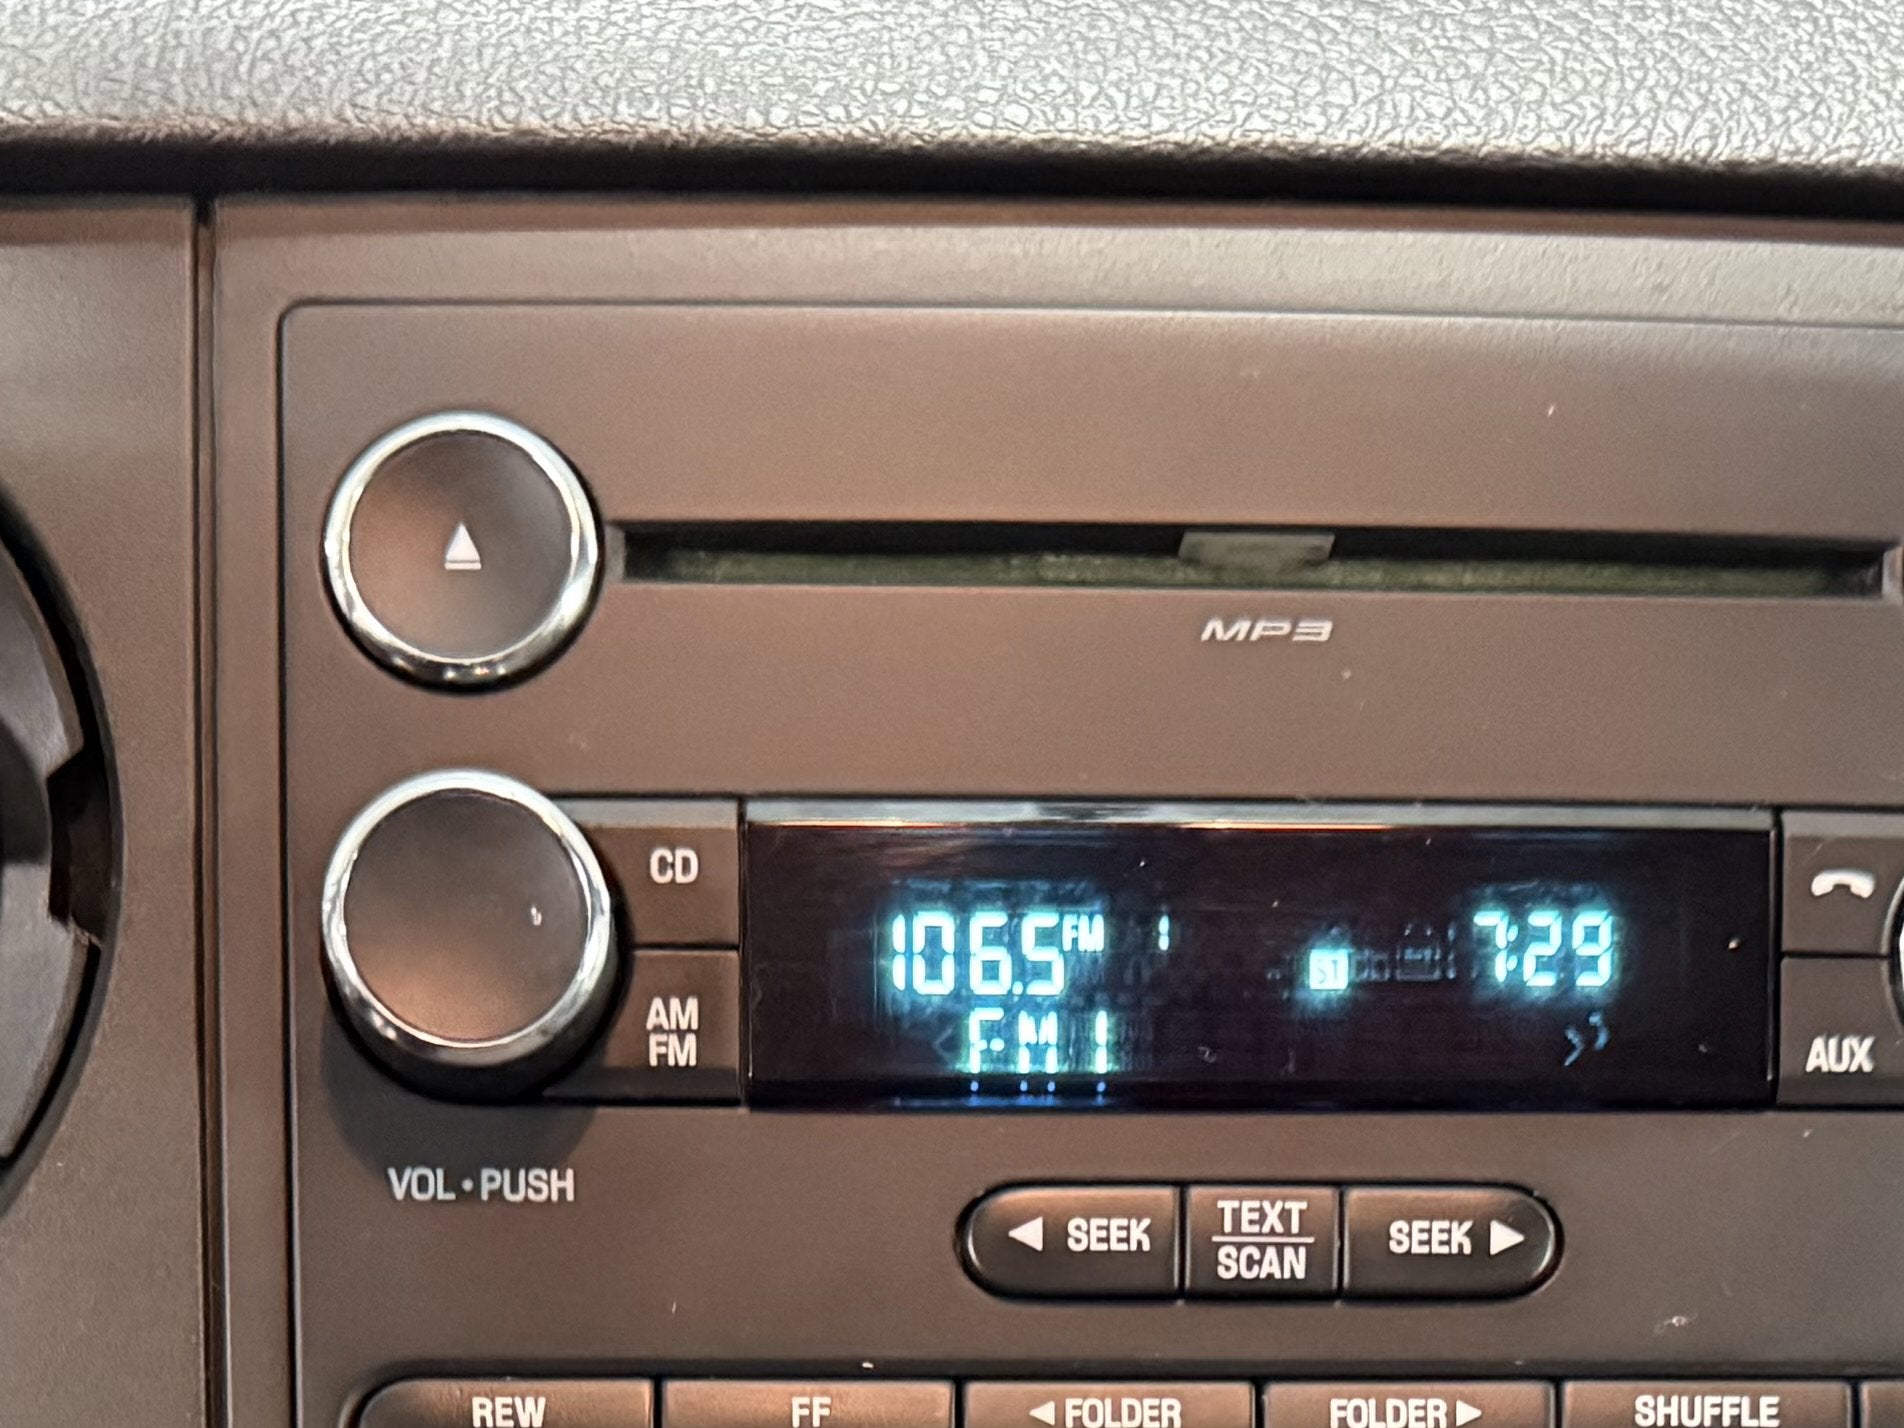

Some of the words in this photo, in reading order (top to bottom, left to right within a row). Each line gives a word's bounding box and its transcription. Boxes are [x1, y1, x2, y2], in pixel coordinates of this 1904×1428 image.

[1199, 617, 1333, 643] MP3
[648, 846, 700, 885] CD
[892, 910, 1065, 998] 106.5
[1472, 909, 1616, 990] 7:29
[644, 994, 700, 1031] AM
[647, 1032, 699, 1070] FM
[1803, 1034, 1876, 1075] AUX
[1065, 1215, 1153, 1253] SEEK
[1215, 1198, 1309, 1235] TEXT
[1387, 1218, 1474, 1256] SEEK
[1215, 1242, 1309, 1282] SCAN
[470, 1393, 547, 1428] REW
[791, 1395, 832, 1428] FF
